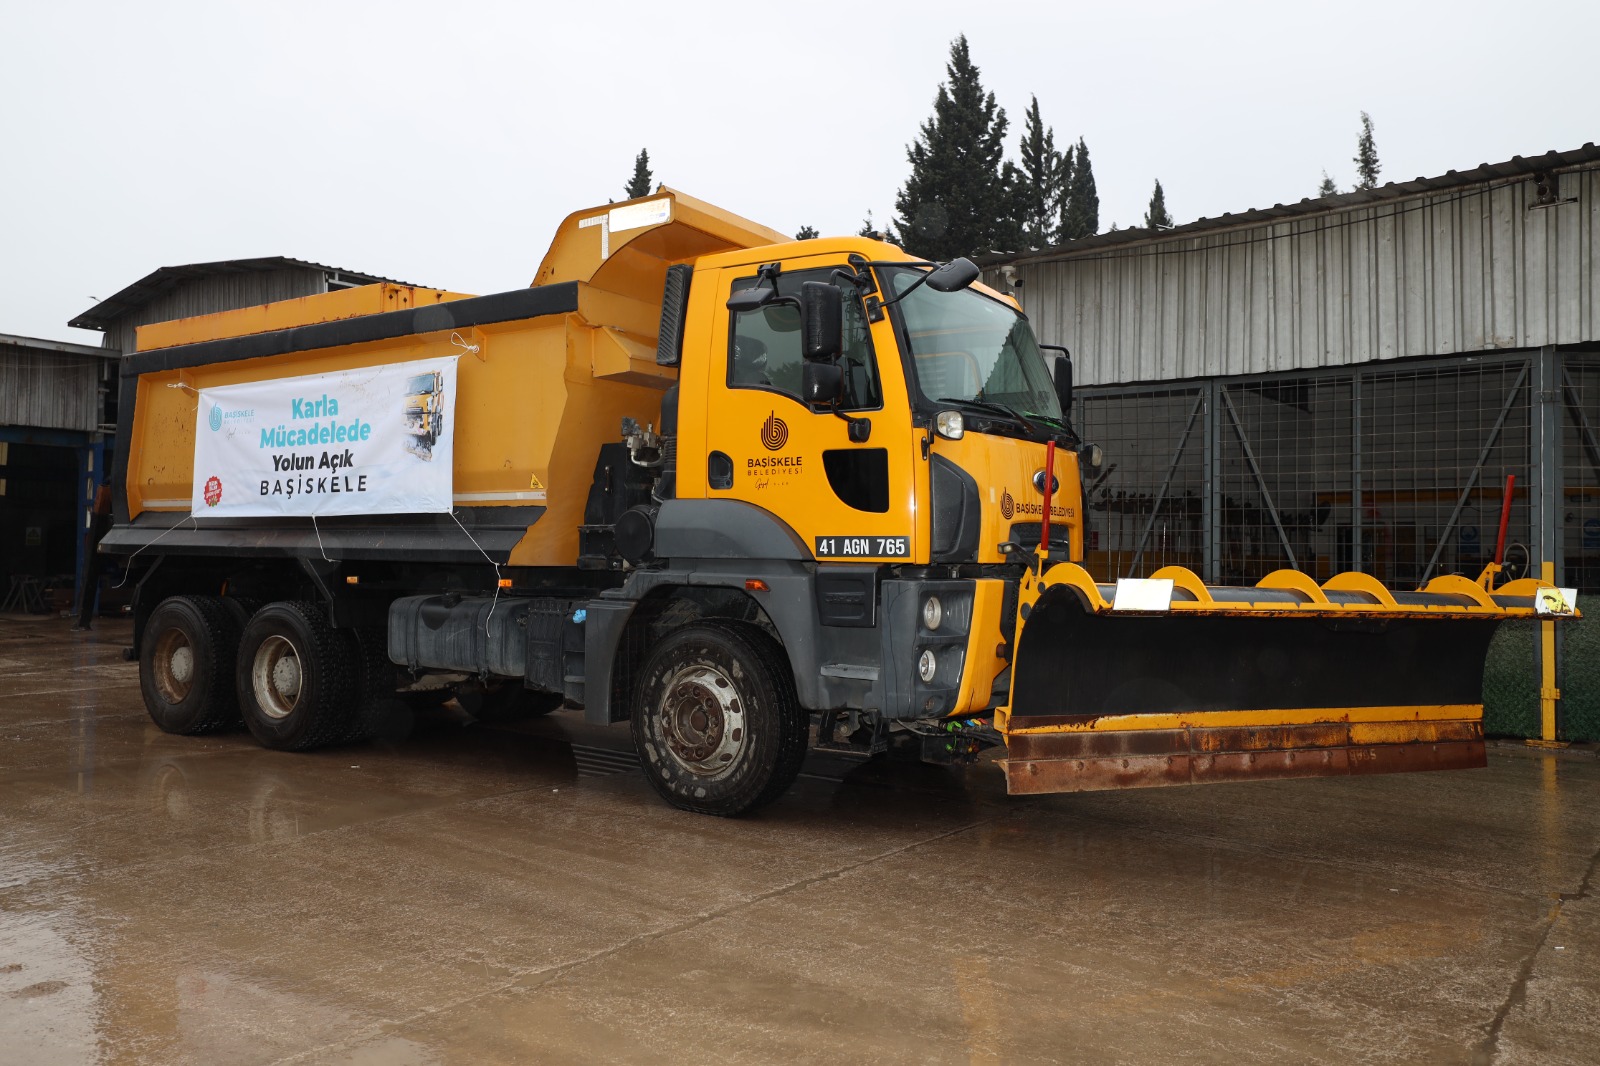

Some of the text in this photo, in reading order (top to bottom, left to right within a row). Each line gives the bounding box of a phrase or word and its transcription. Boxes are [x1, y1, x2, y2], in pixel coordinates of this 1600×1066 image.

[291, 394, 339, 419] Karla
[259, 418, 371, 448] Mücadelede
[272, 449, 354, 474] Yolun Açık
[747, 456, 803, 468] BAŞİSKELE
[747, 467, 803, 476] BELEDİYESİ
[260, 474, 367, 499] BAŞİSKELE
[819, 538, 905, 554] 41 AGN 765
